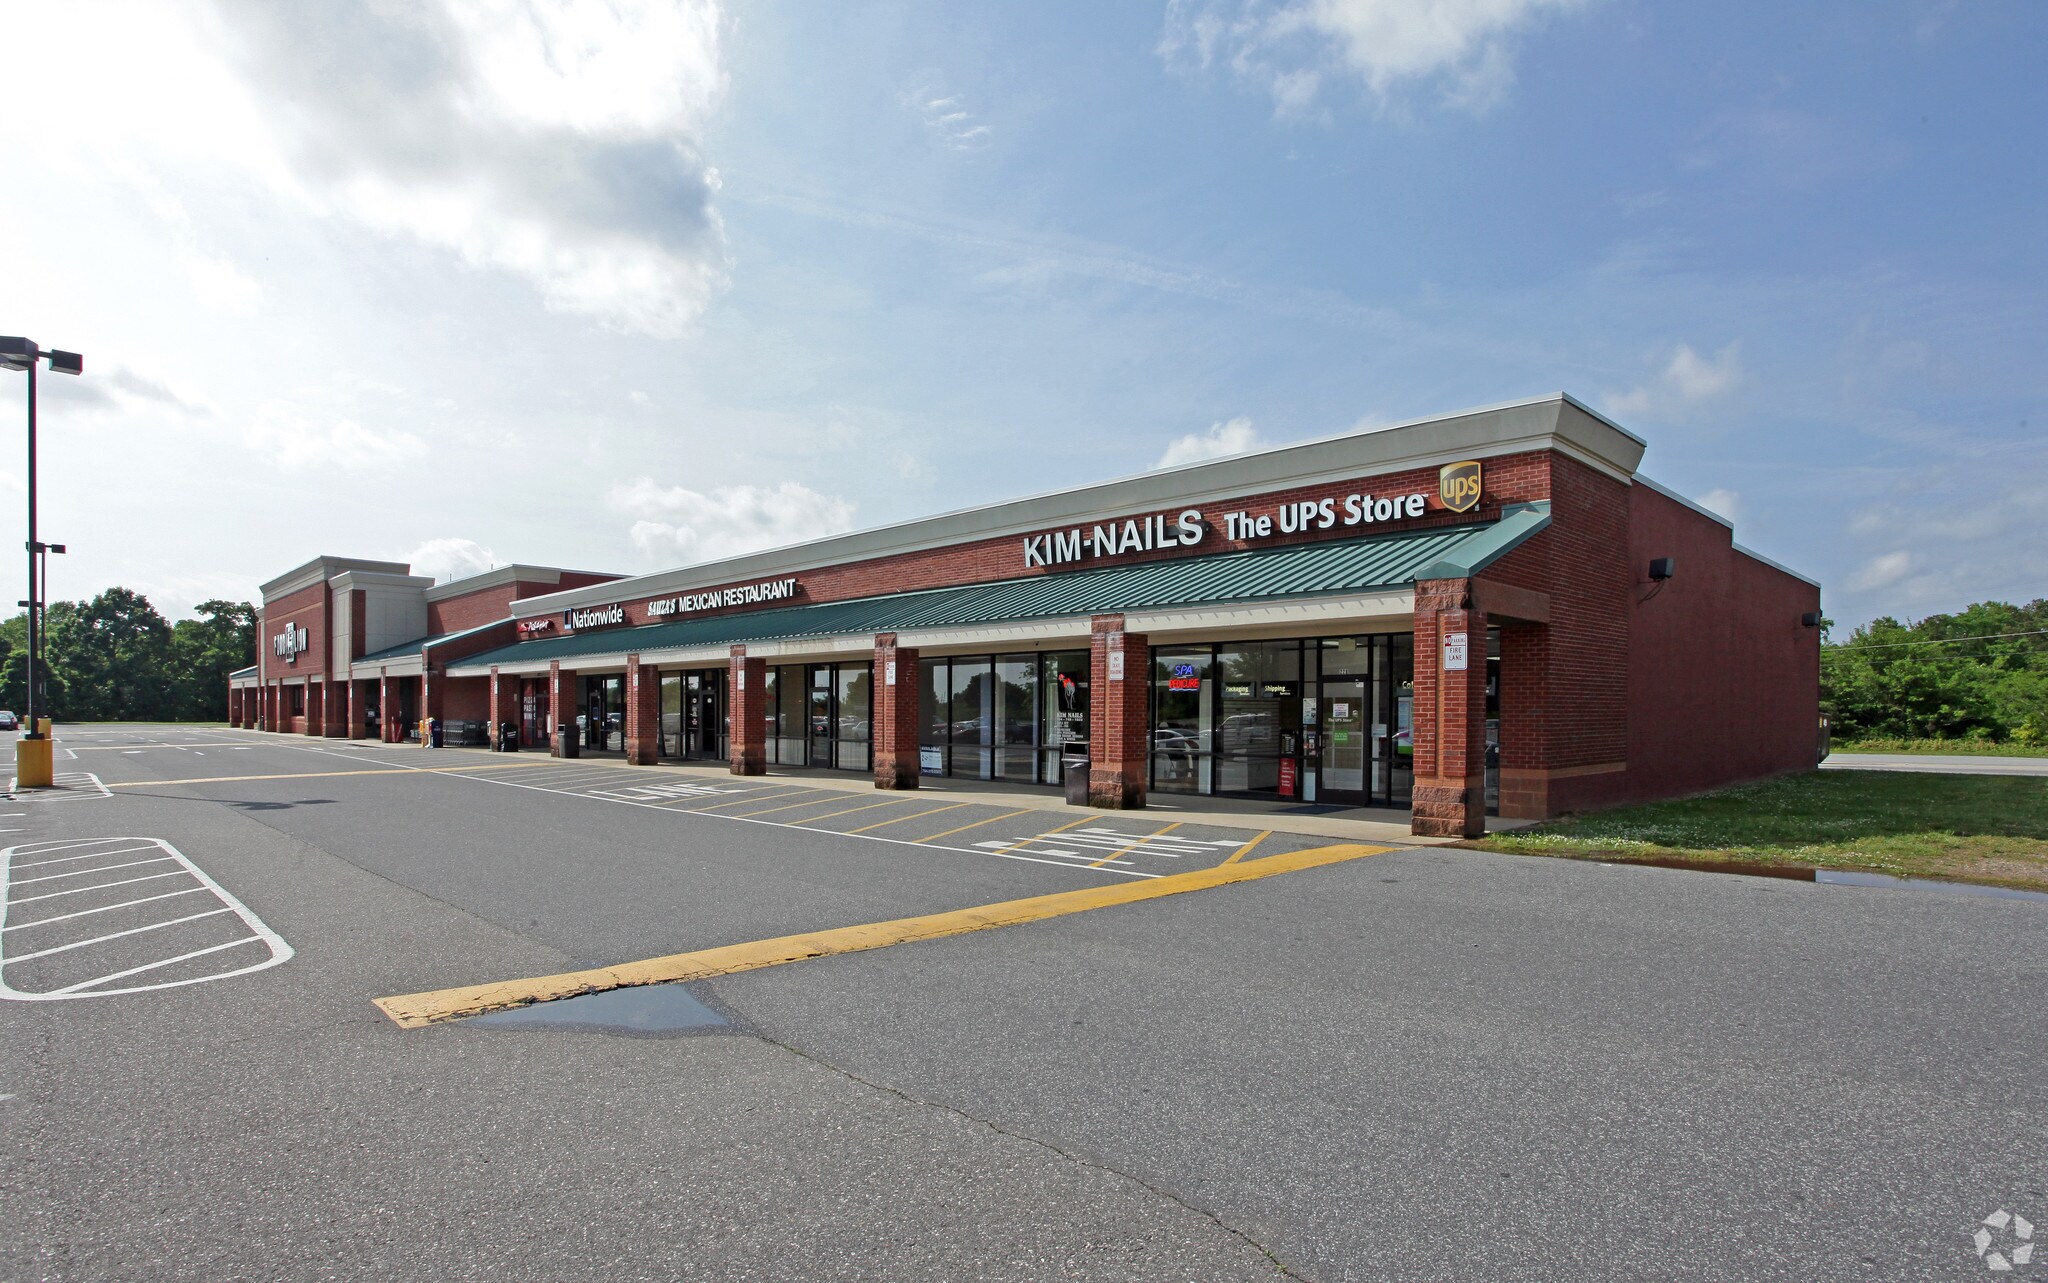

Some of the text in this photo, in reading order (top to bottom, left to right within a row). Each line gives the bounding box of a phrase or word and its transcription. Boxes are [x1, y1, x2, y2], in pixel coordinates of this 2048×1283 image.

[1443, 475, 1478, 505] ups
[1223, 493, 1425, 541] The UPS Store
[1023, 509, 1203, 568] KIM-NAILS
[678, 591, 722, 613] MEXICAN
[724, 578, 796, 607] RESTAURANT
[573, 604, 623, 629] Nationwide
[1168, 677, 1199, 689] PEDICURE
[1174, 665, 1193, 676] SPA
